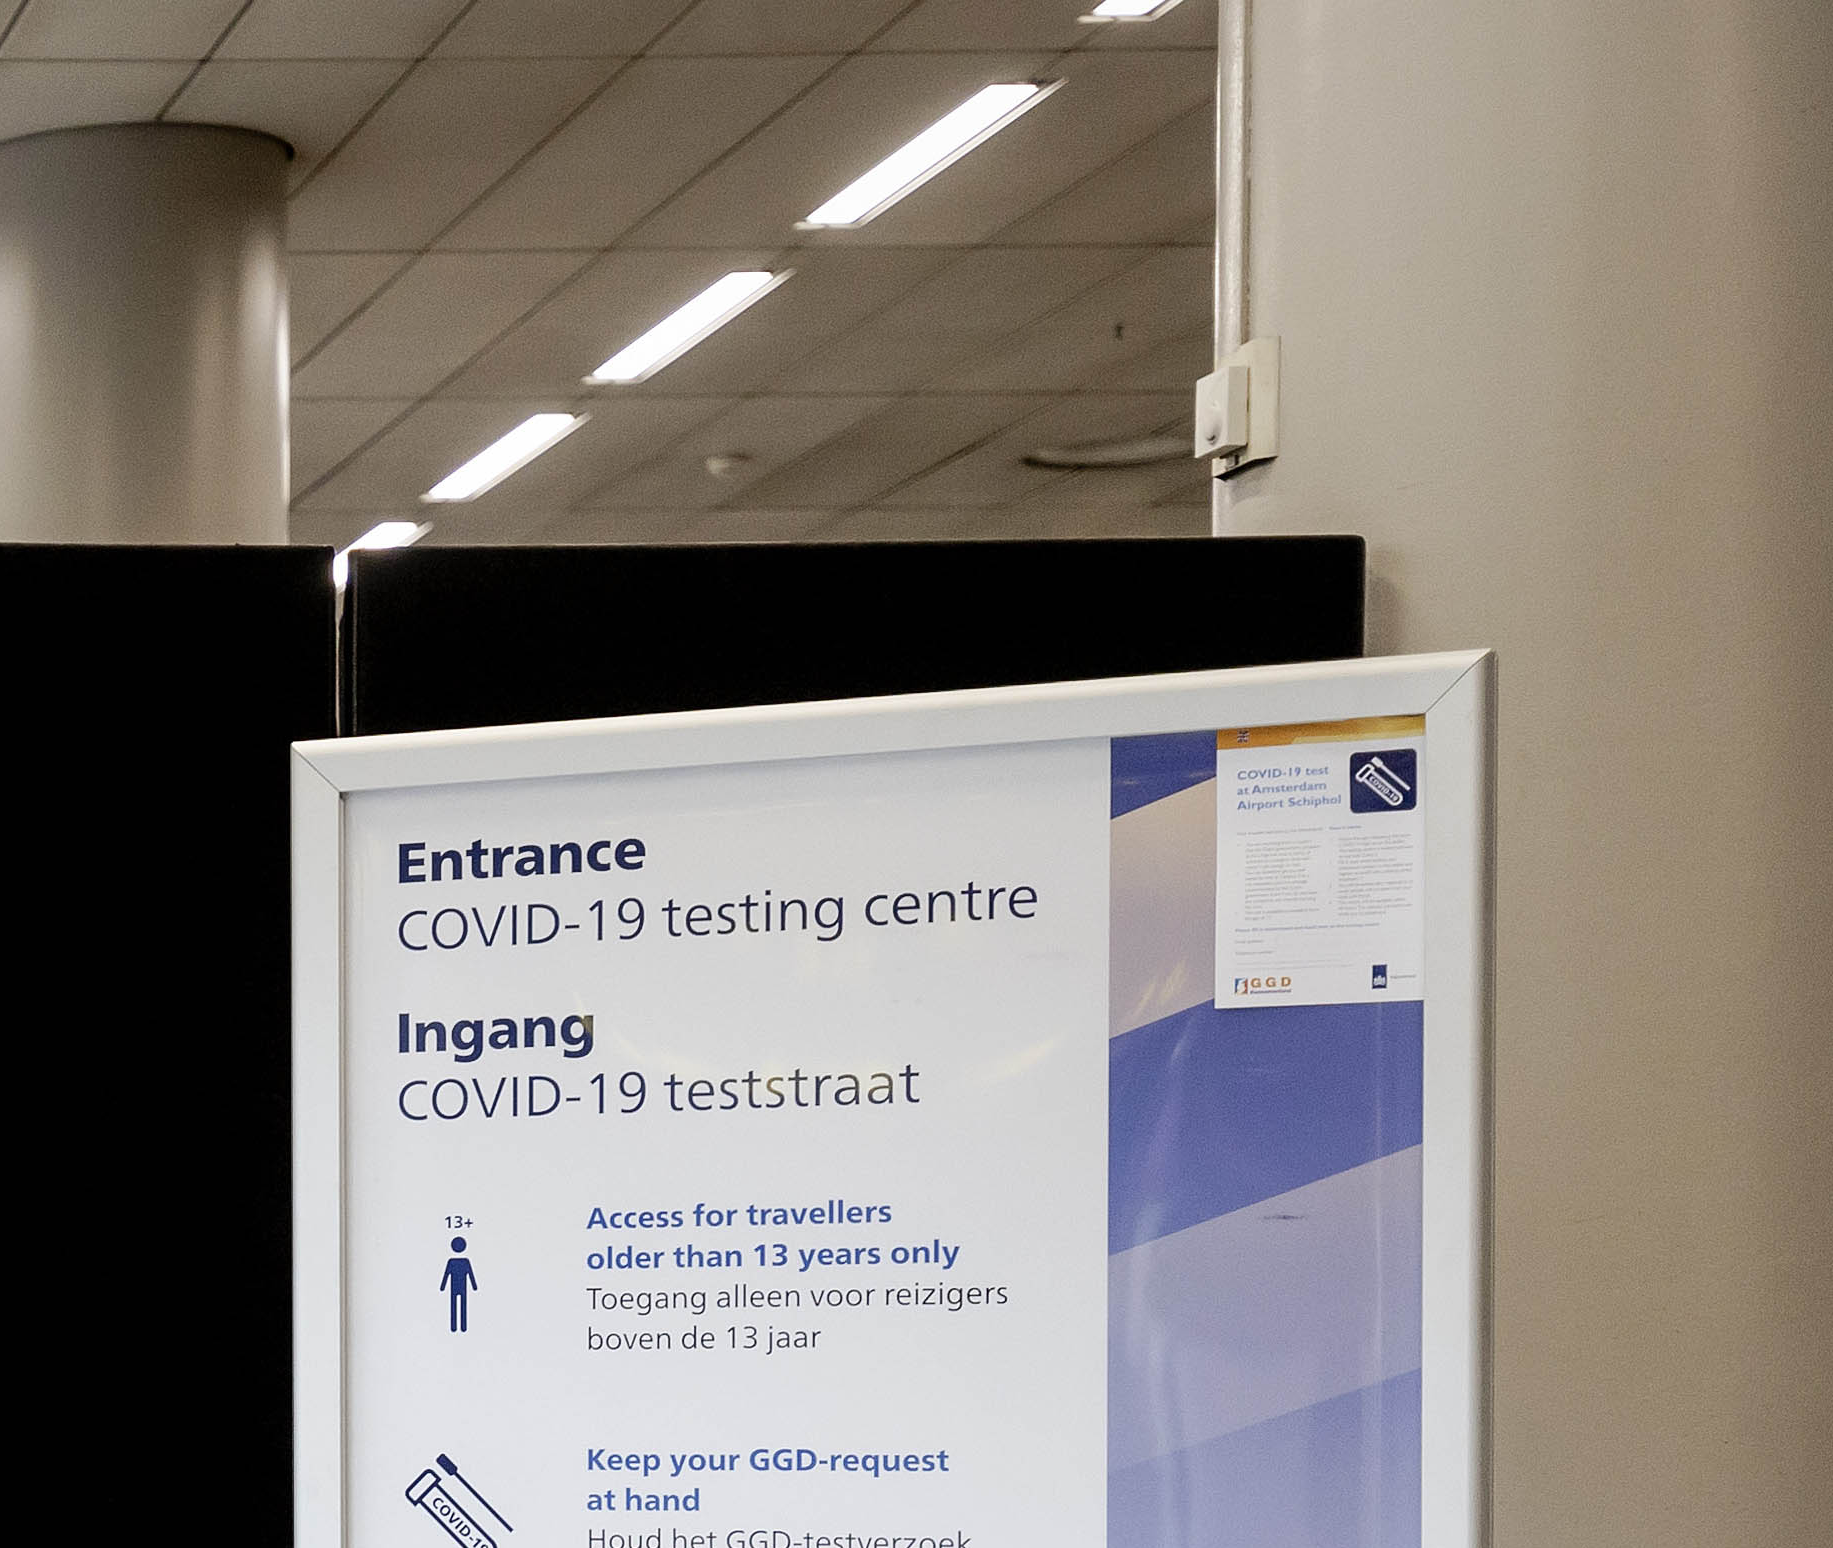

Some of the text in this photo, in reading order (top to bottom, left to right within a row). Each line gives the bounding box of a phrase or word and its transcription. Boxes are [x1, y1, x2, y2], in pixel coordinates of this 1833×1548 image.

[1237, 766, 1328, 780] COVID-19 test
[1237, 782, 1327, 795] at Amsterdam
[1237, 794, 1341, 811] Airport Schiphol
[1368, 775, 1399, 803] COVID-19
[399, 839, 646, 883] Entrance
[399, 882, 1037, 950] COVID-19 testing centre
[399, 1013, 593, 1063] Ingang
[399, 1064, 920, 1120] COVID-19 teststraat
[444, 1215, 474, 1229] 13+
[587, 1200, 891, 1229] Access for travellers
[587, 1239, 959, 1272] older than 13 years only
[586, 1282, 1008, 1316] Toegang alleen voor reizigers
[588, 1325, 821, 1355] boven de 13 jaar
[588, 1449, 949, 1477] Keep your GGD-request
[587, 1488, 699, 1511] at hand
